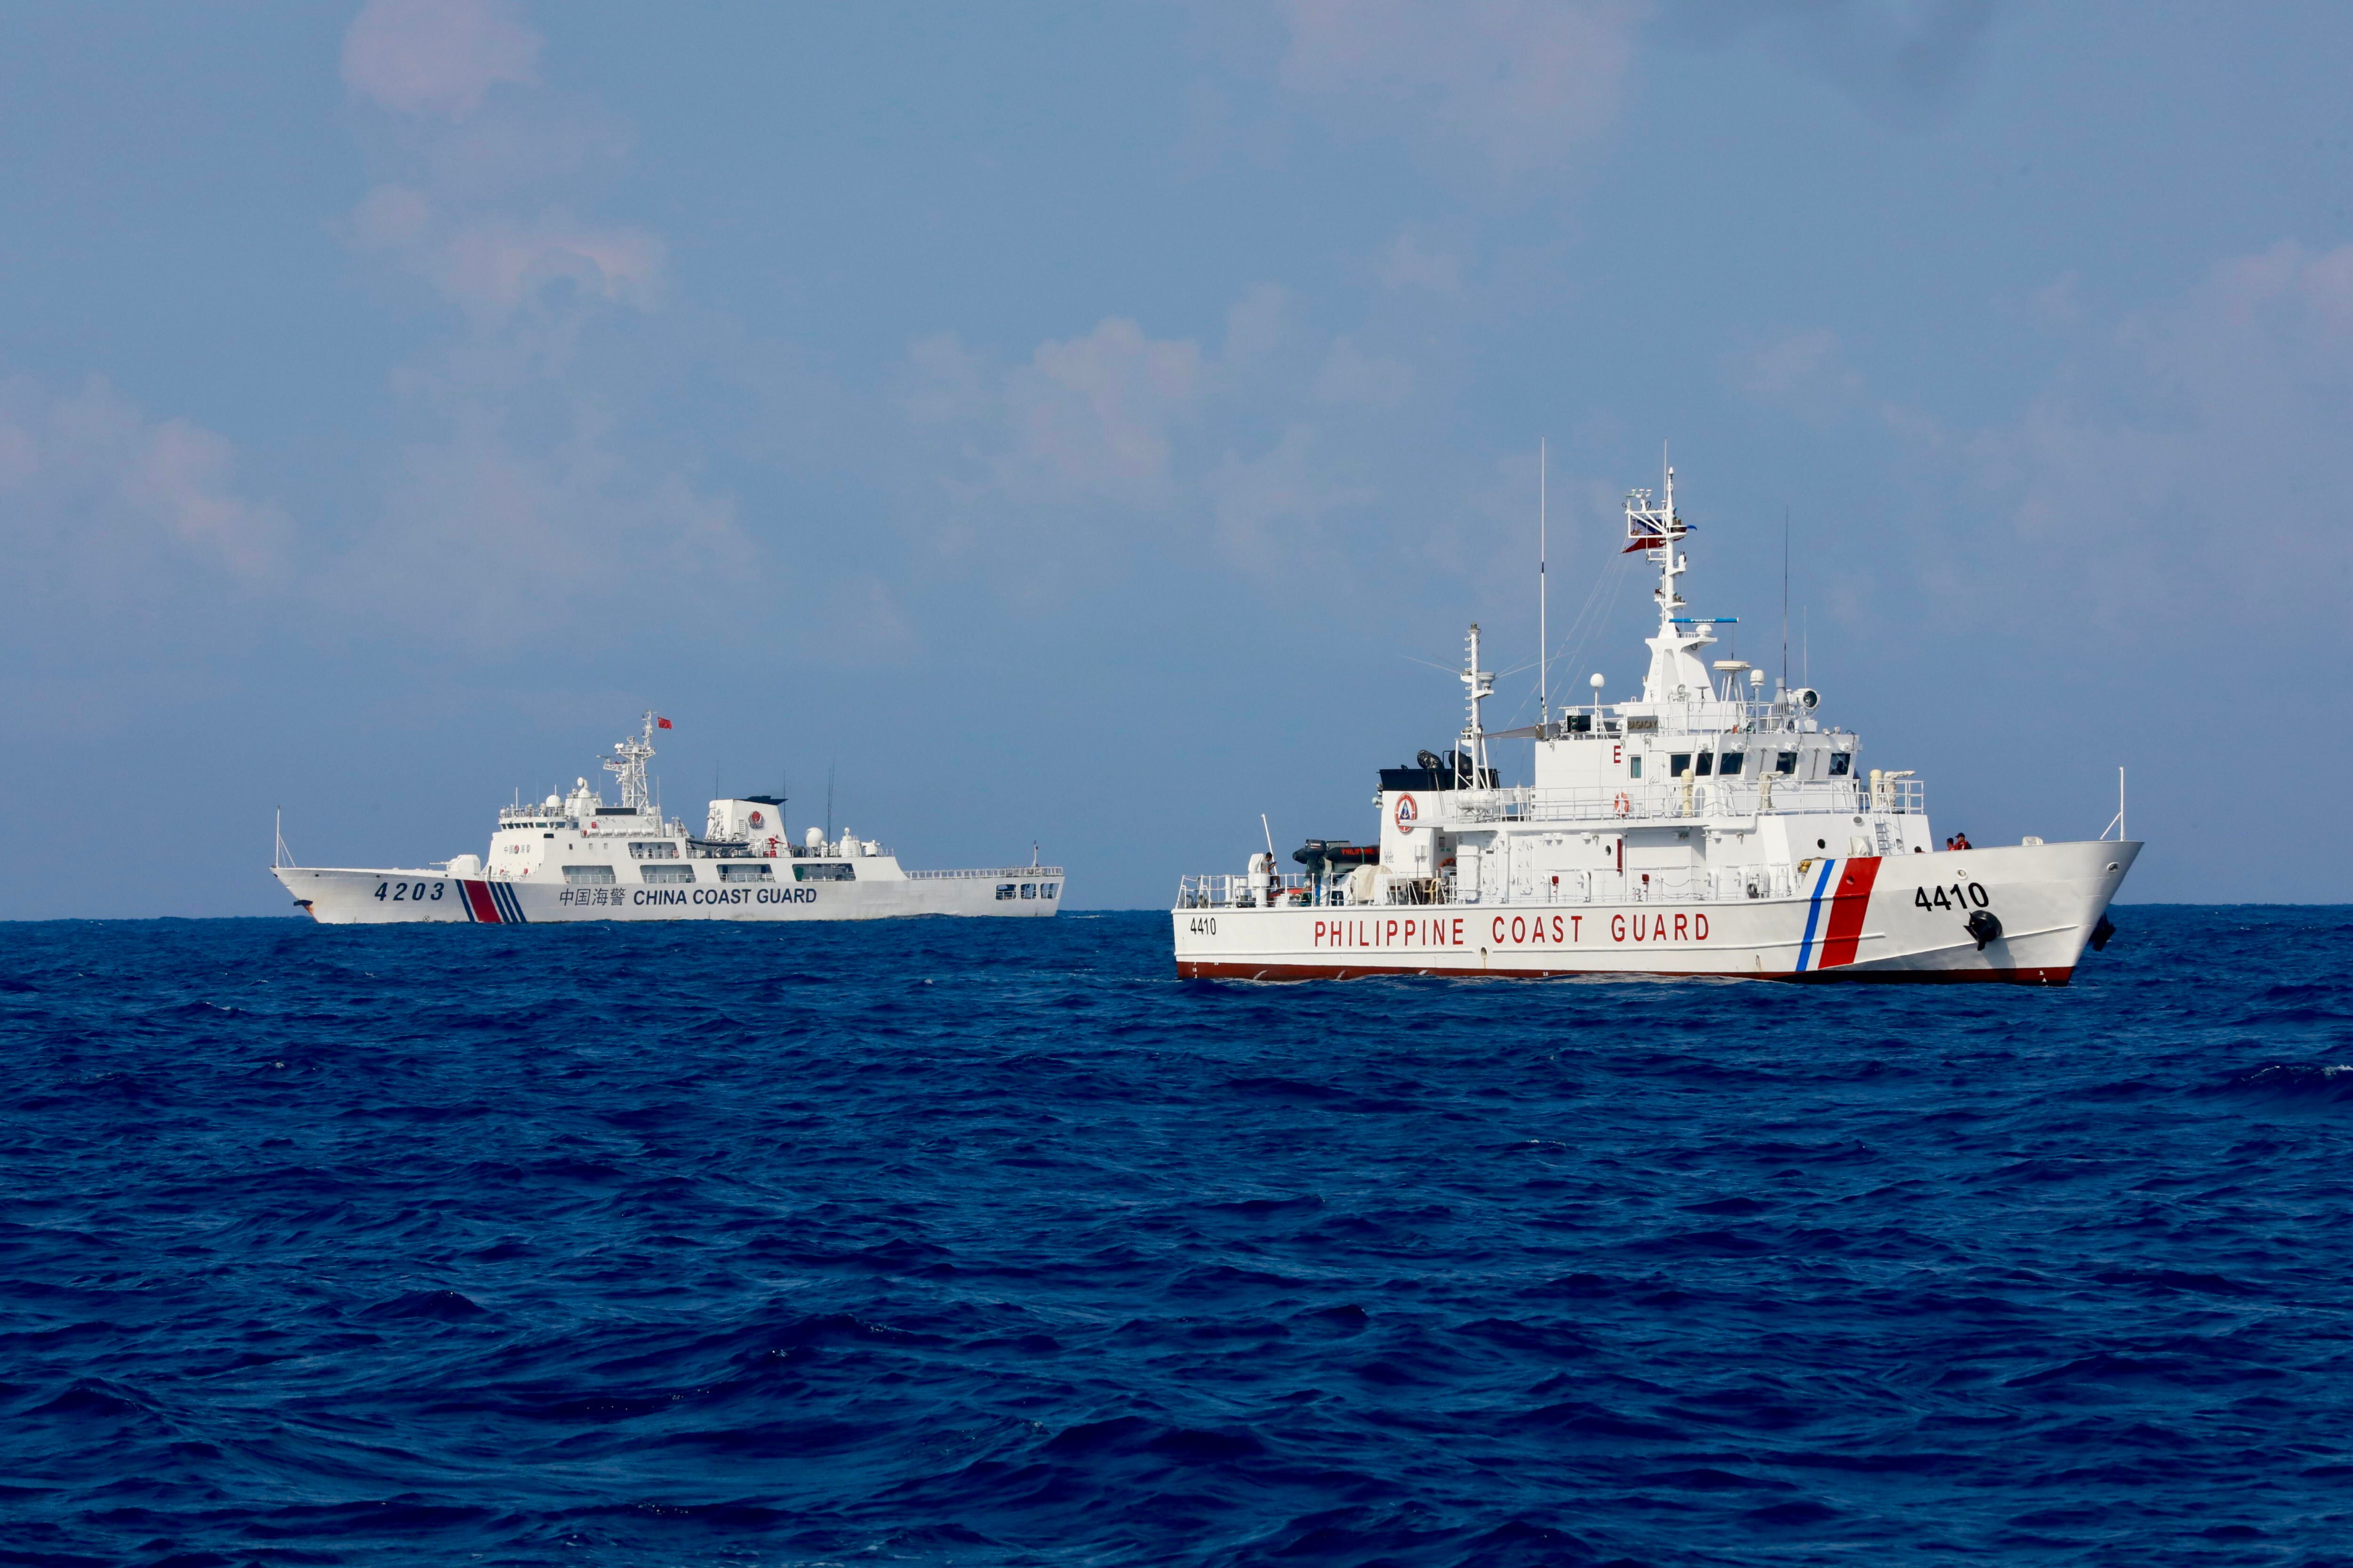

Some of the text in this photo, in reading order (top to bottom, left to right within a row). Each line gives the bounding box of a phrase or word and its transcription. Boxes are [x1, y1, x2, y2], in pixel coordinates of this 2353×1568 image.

[1628, 720, 1657, 729] BAGACAY
[1614, 745, 1621, 763] E
[374, 882, 445, 901] 4203
[560, 887, 626, 906] 中国海警
[633, 888, 817, 905] CHINA COAST GUARD
[1915, 882, 1989, 912] 4410
[1190, 917, 1216, 935] 4410
[1315, 913, 1709, 947] PHILIPPINE COAST GUARD
